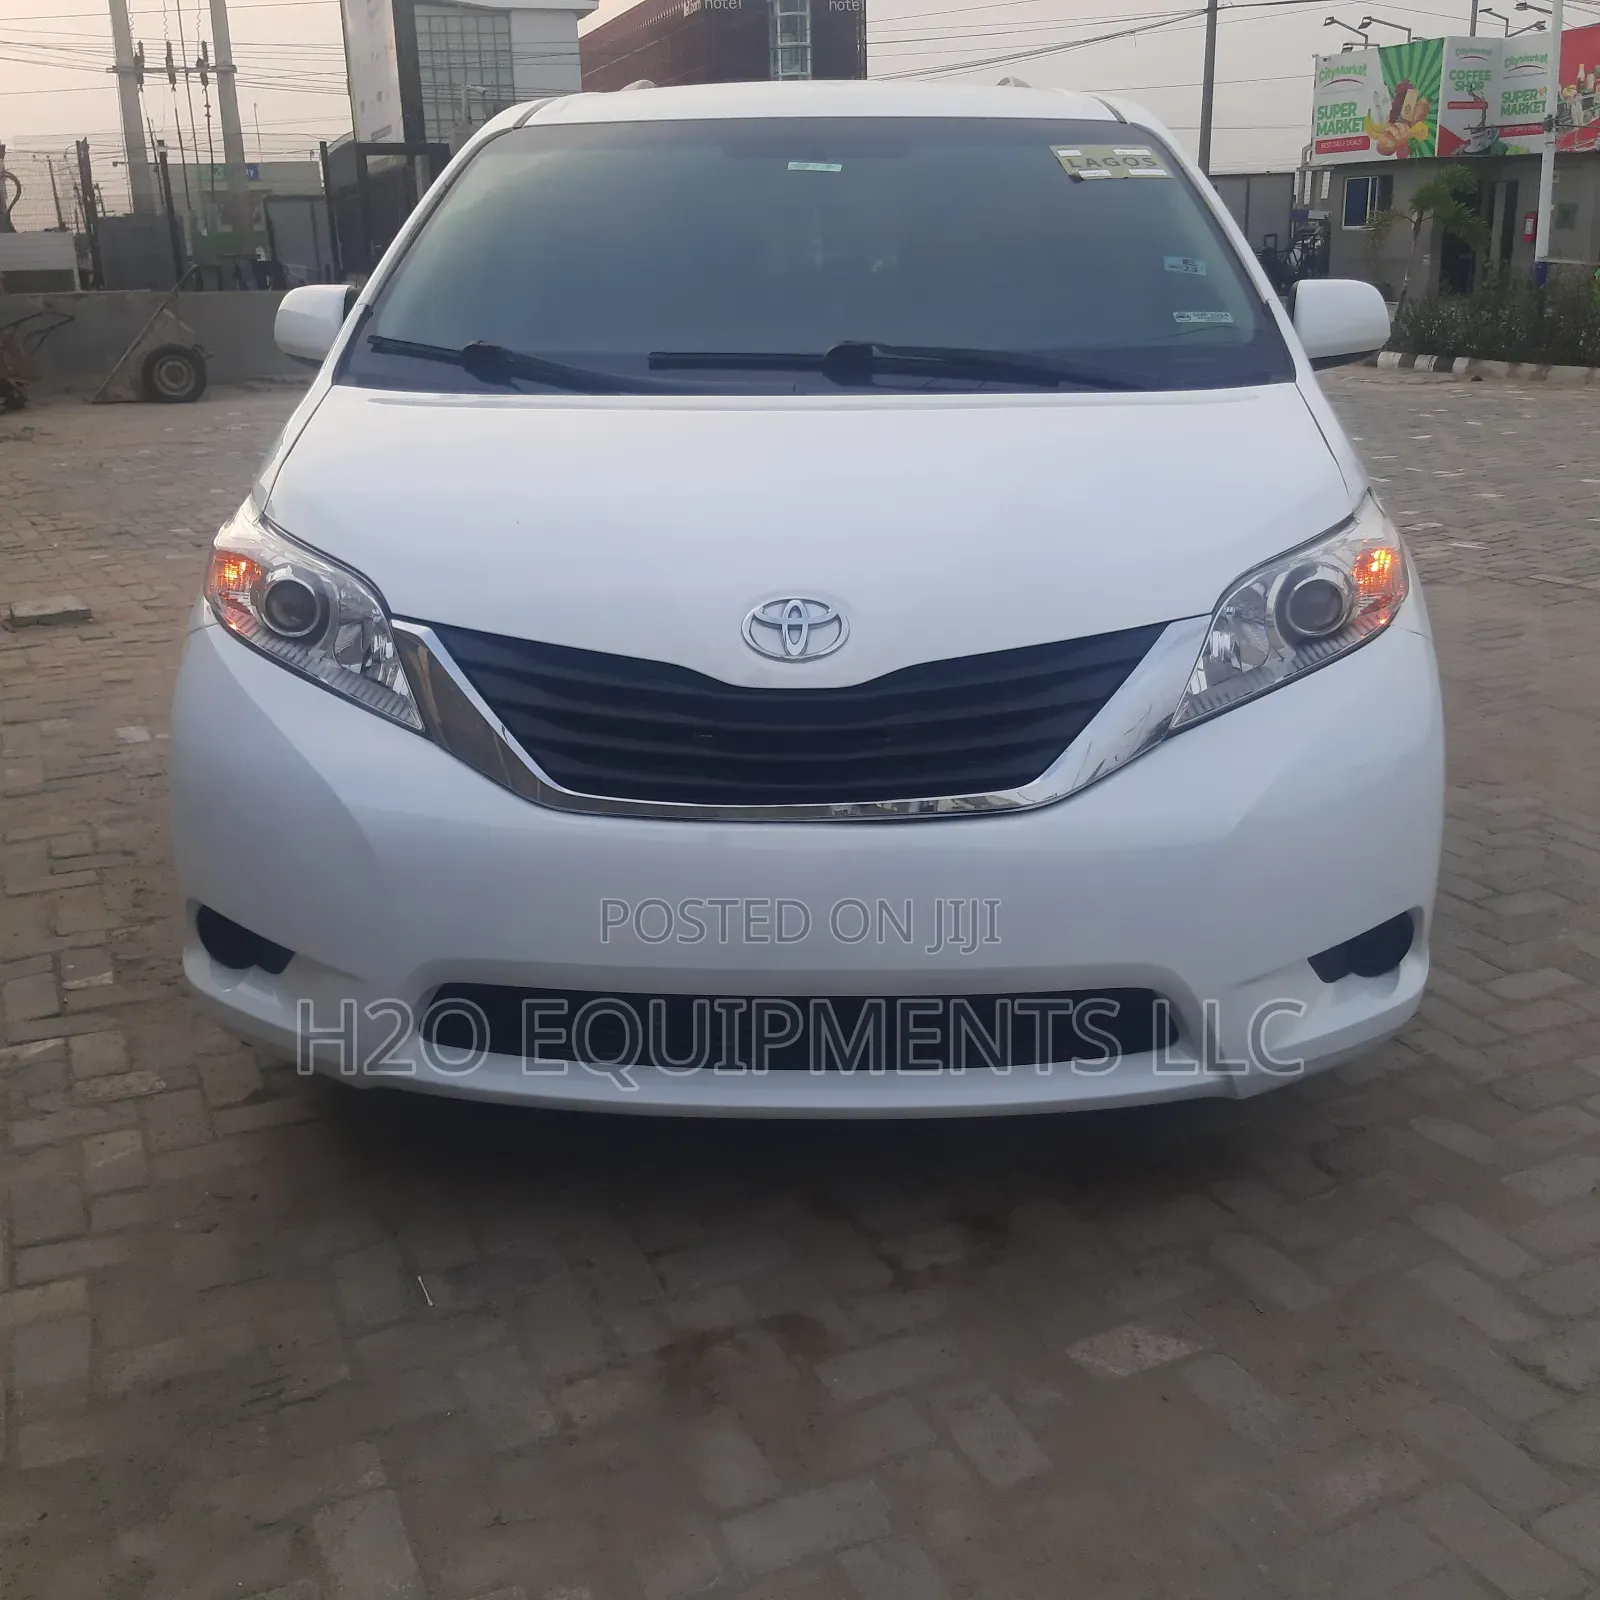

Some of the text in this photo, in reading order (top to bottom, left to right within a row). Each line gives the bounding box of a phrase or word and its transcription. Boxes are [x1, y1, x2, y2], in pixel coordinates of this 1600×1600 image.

[704, 0, 742, 10] hotel
[829, 0, 865, 11] hotel
[1449, 70, 1492, 81] COFFEE
[1454, 81, 1484, 92] SHOP
[1501, 88, 1538, 103] SUPER
[1317, 102, 1357, 120] SUPER
[1500, 101, 1546, 117] MARKET
[1316, 117, 1367, 136] MARKET
[1066, 157, 1157, 168] LAGOS
